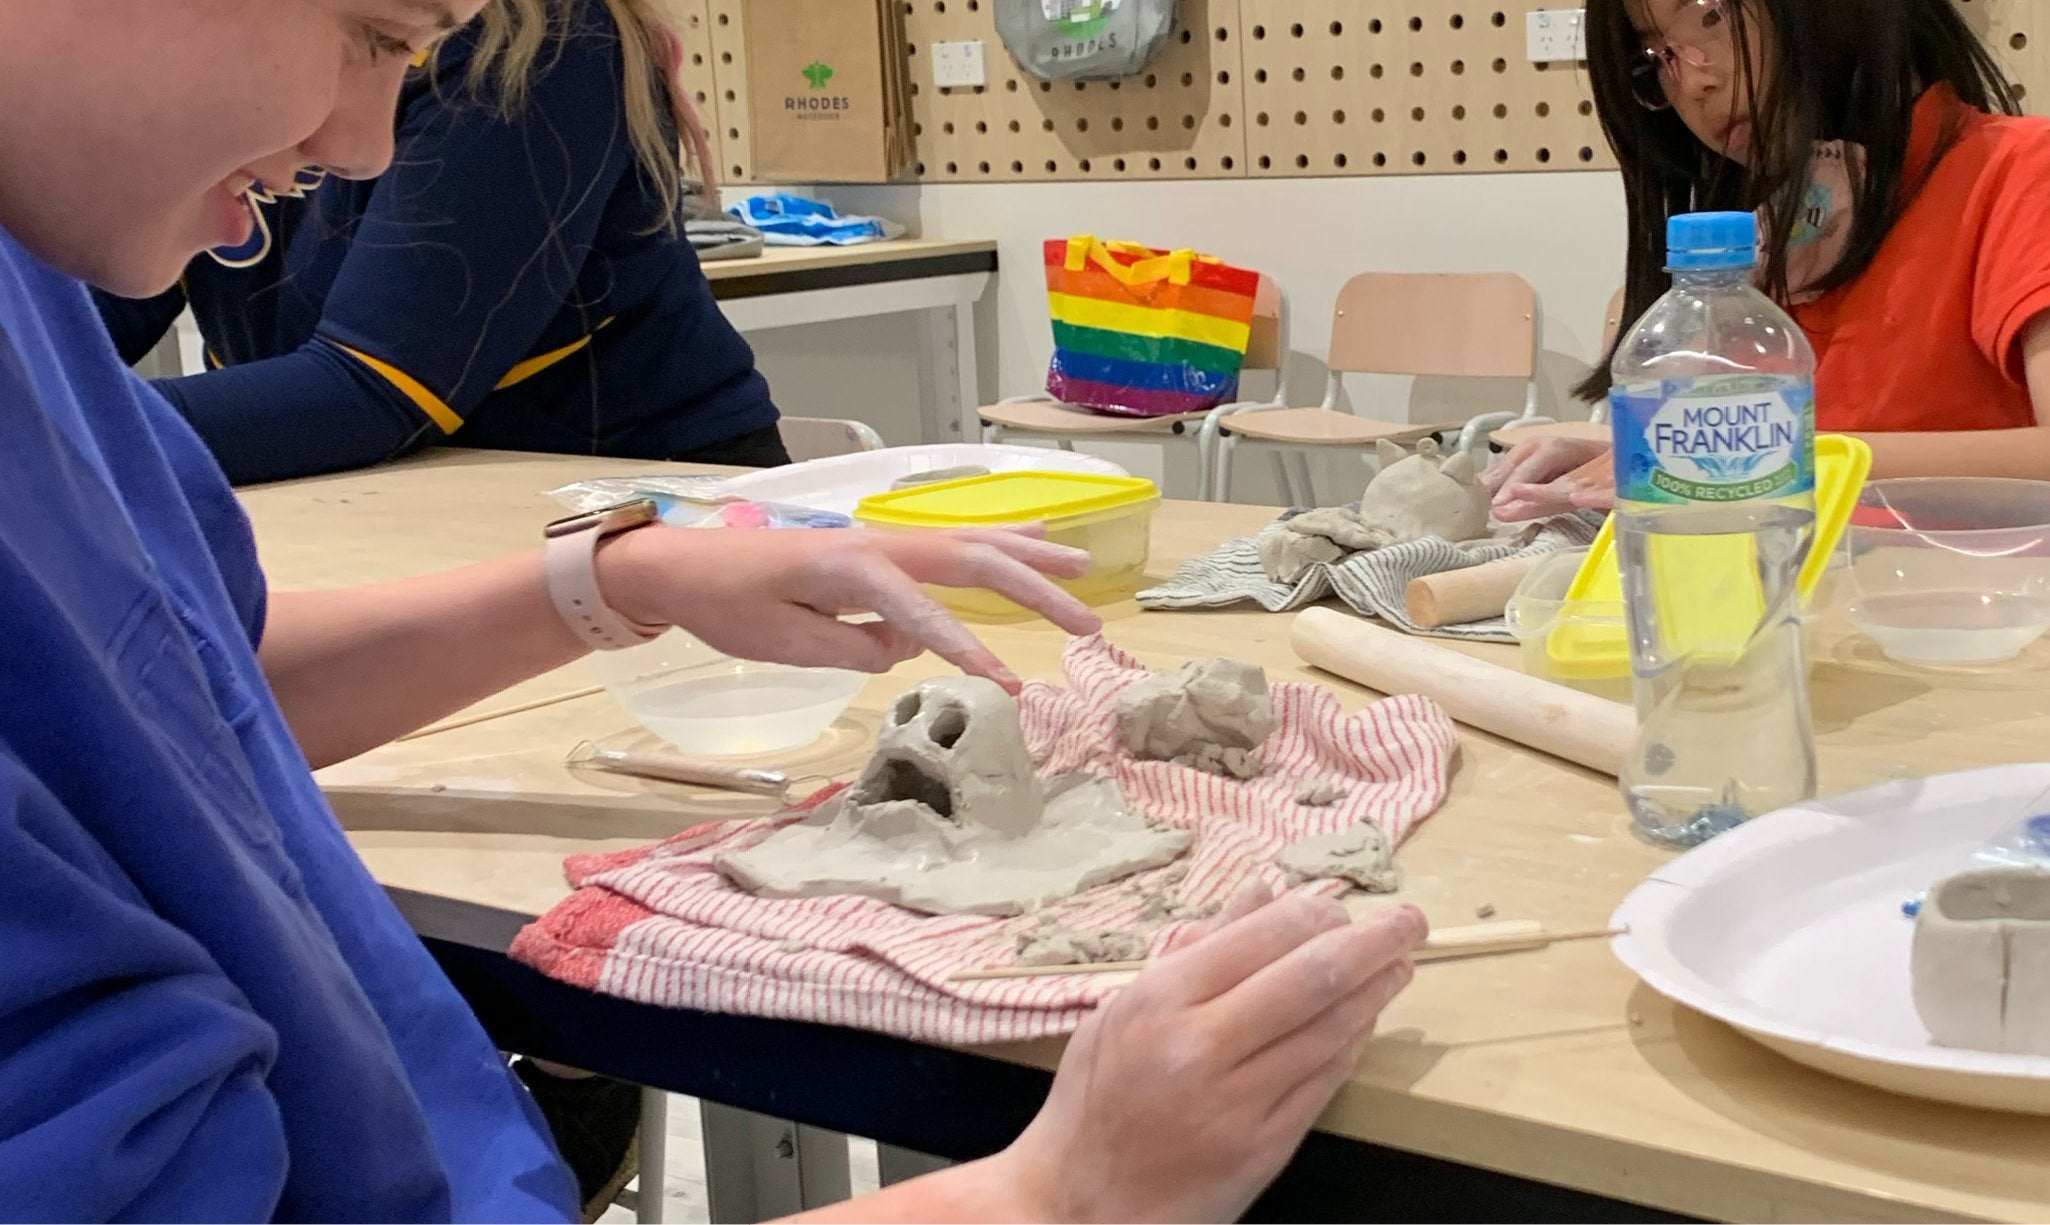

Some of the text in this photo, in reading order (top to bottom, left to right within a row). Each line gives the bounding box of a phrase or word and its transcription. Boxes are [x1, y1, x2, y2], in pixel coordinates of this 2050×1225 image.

[785, 97, 849, 110] RHODES
[1683, 402, 1772, 428] MOUNT
[1655, 420, 1794, 454] FRANKLIN
[1655, 474, 1773, 500] 100% RECYCLED
